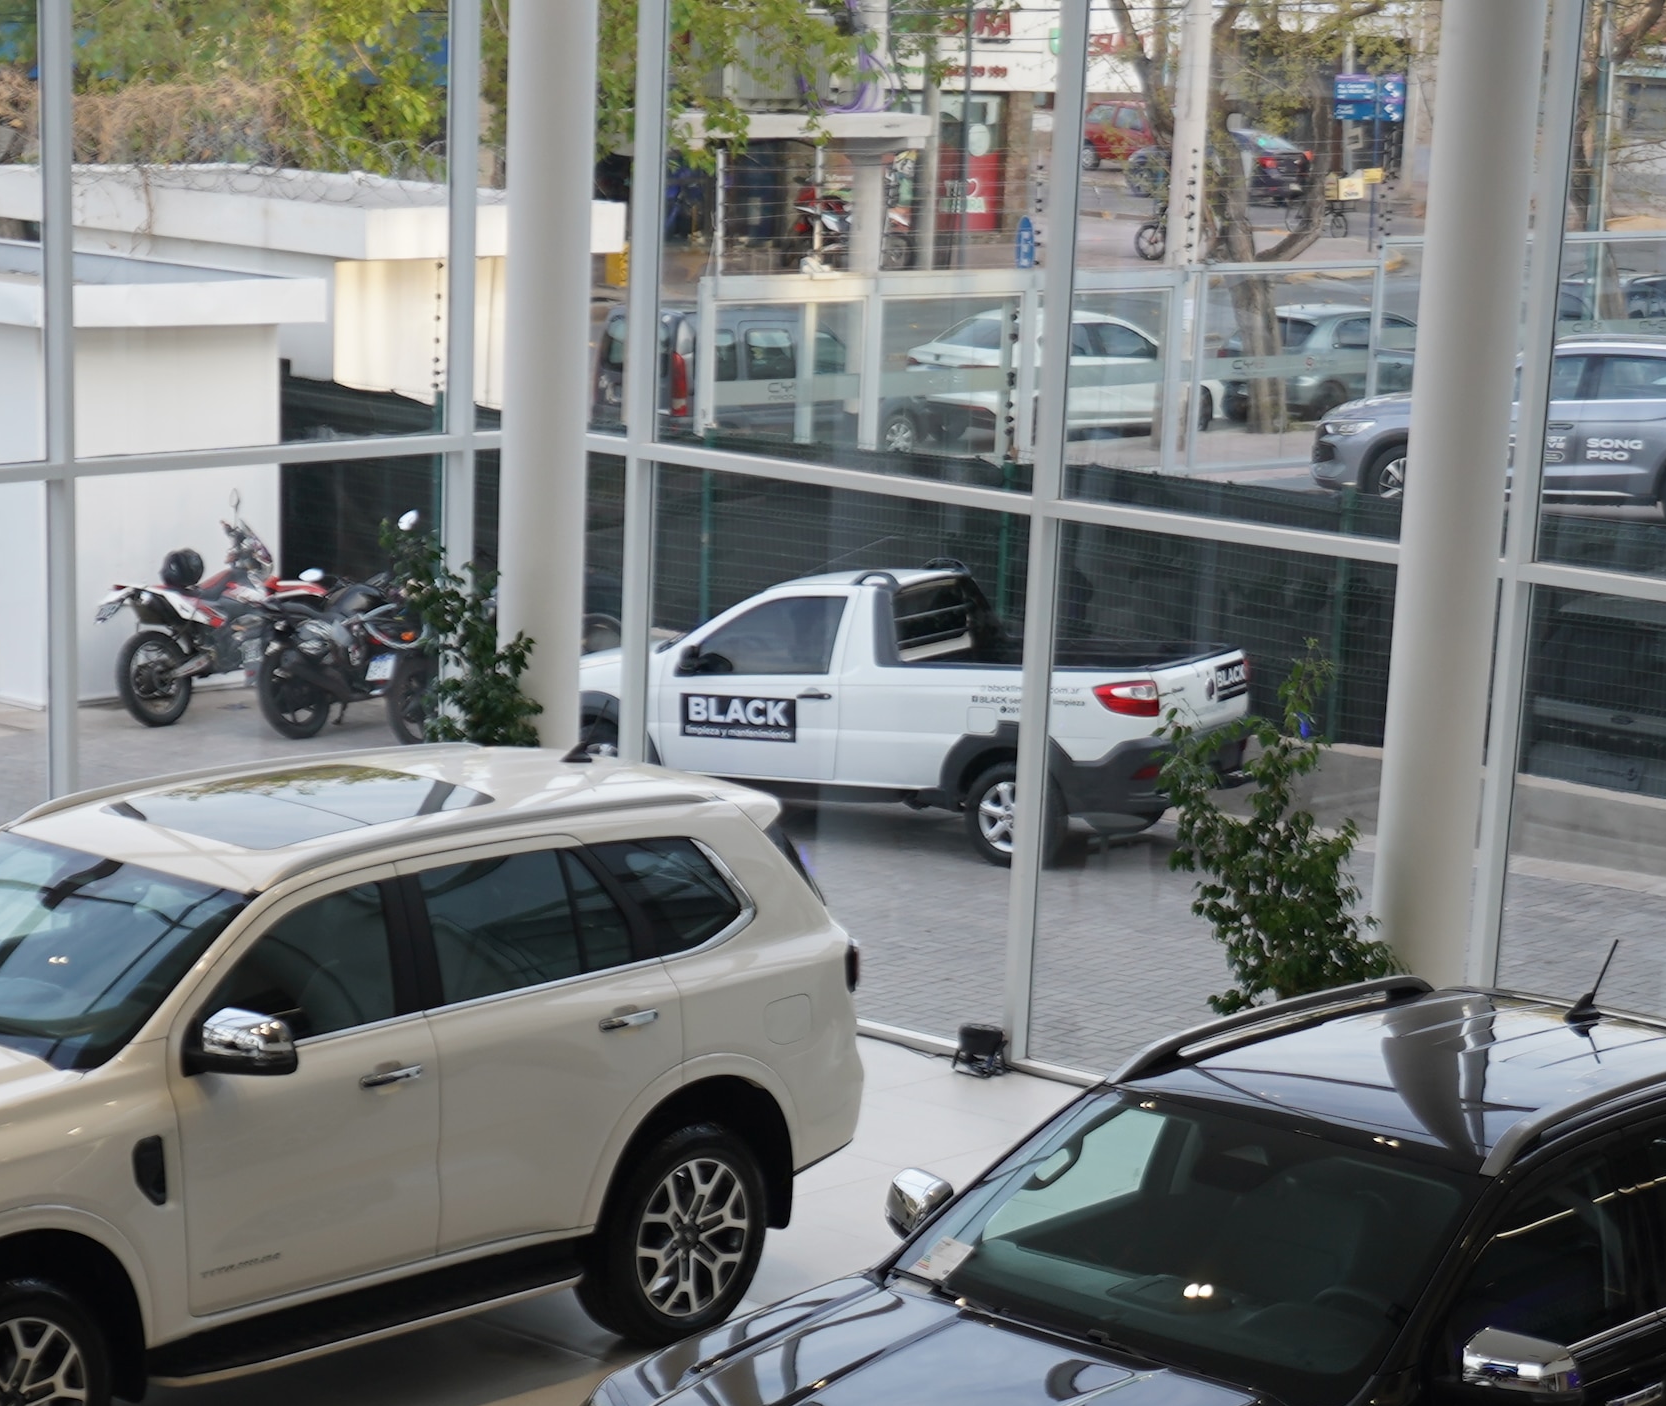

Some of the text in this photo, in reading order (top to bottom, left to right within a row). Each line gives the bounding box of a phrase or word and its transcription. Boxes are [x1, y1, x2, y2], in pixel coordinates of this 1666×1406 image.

[1586, 437, 1643, 450] SONG
[1586, 450, 1629, 461] PRO
[1216, 663, 1247, 688] BLACK
[688, 696, 788, 727] BLACK
[685, 725, 791, 740] limpieza y mantenimiento
